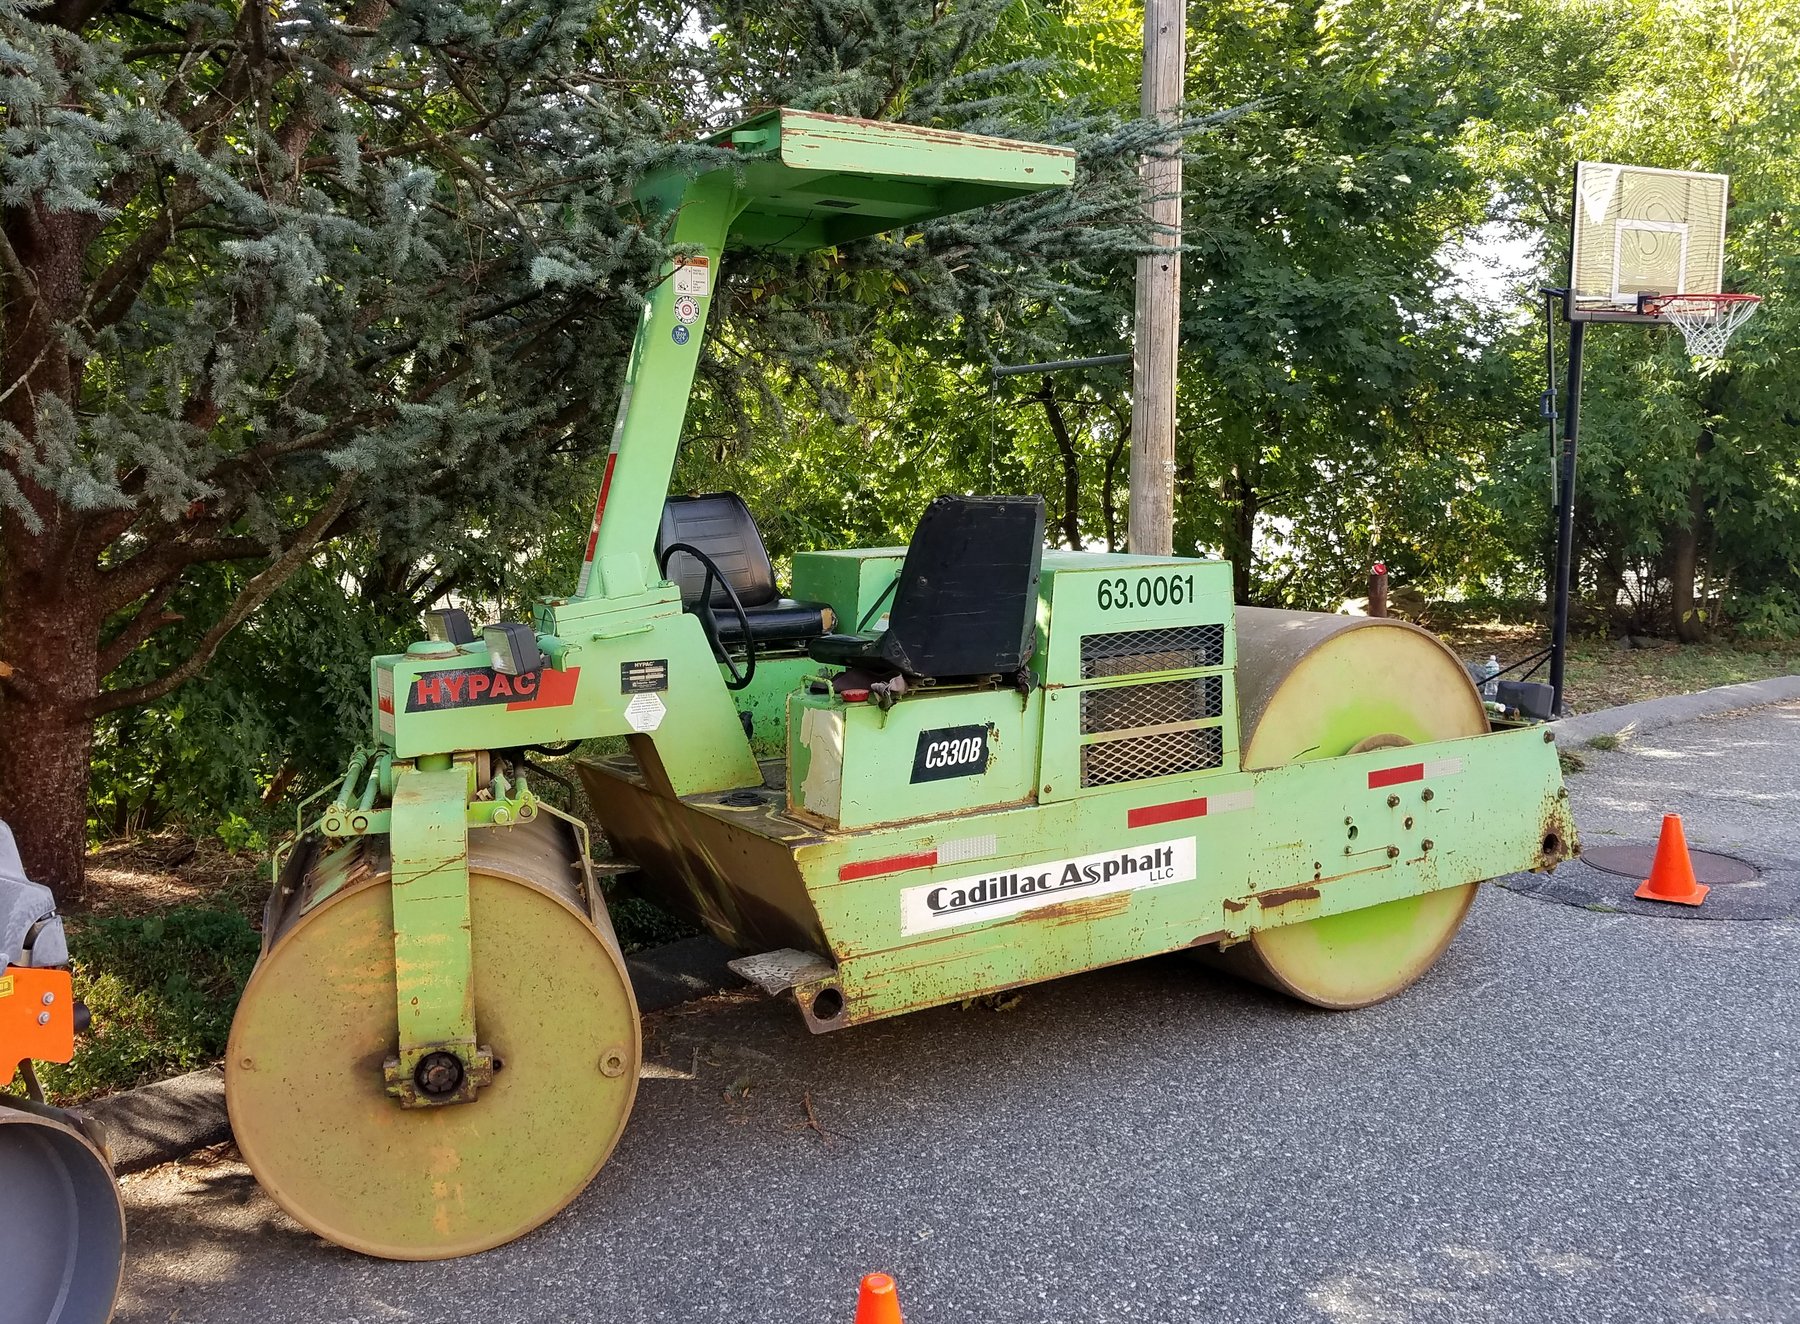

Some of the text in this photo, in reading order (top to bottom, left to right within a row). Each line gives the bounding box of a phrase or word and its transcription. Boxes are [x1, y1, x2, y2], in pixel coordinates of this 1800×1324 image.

[1097, 574, 1195, 611] 63.0061
[417, 672, 536, 705] HYPAC
[925, 736, 982, 769] C330B
[926, 846, 1174, 911] Cadillac Asphalt
[1149, 867, 1174, 882] LLC
